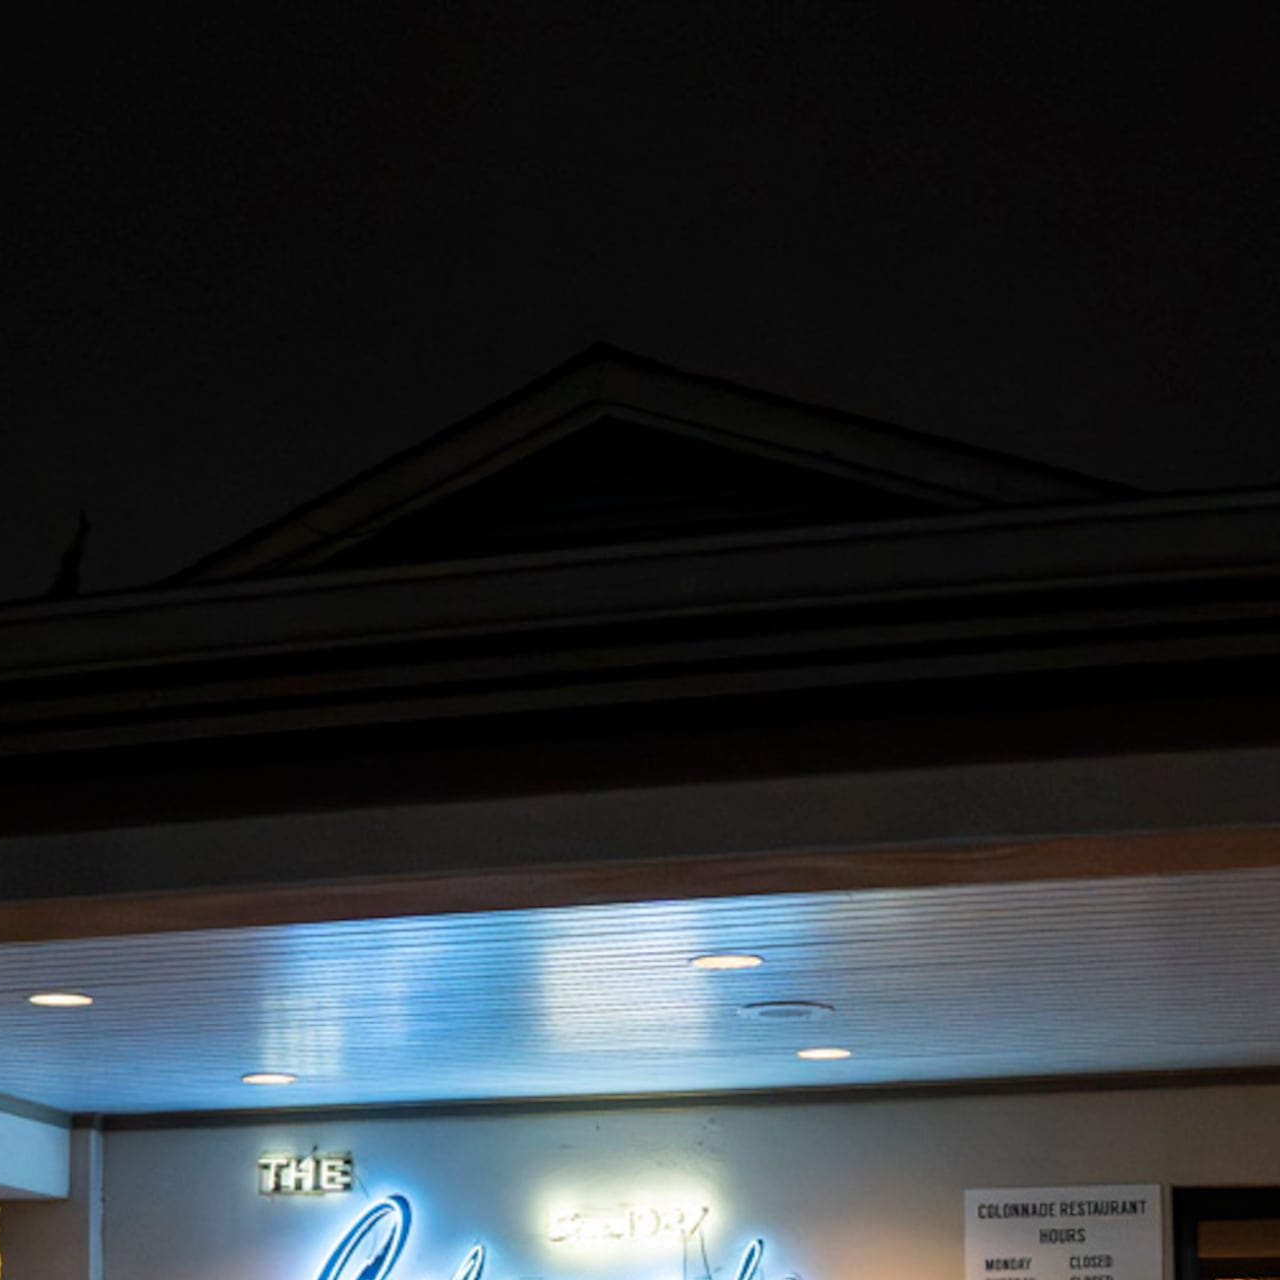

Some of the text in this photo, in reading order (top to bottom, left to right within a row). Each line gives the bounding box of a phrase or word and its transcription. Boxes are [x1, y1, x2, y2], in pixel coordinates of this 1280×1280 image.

[257, 1153, 352, 1192] THE
[978, 1200, 1146, 1219] COLONNADE RESTAURANT
[1039, 1228, 1086, 1244] HOURS
[985, 1255, 1112, 1271] MONDAY CLOSED
